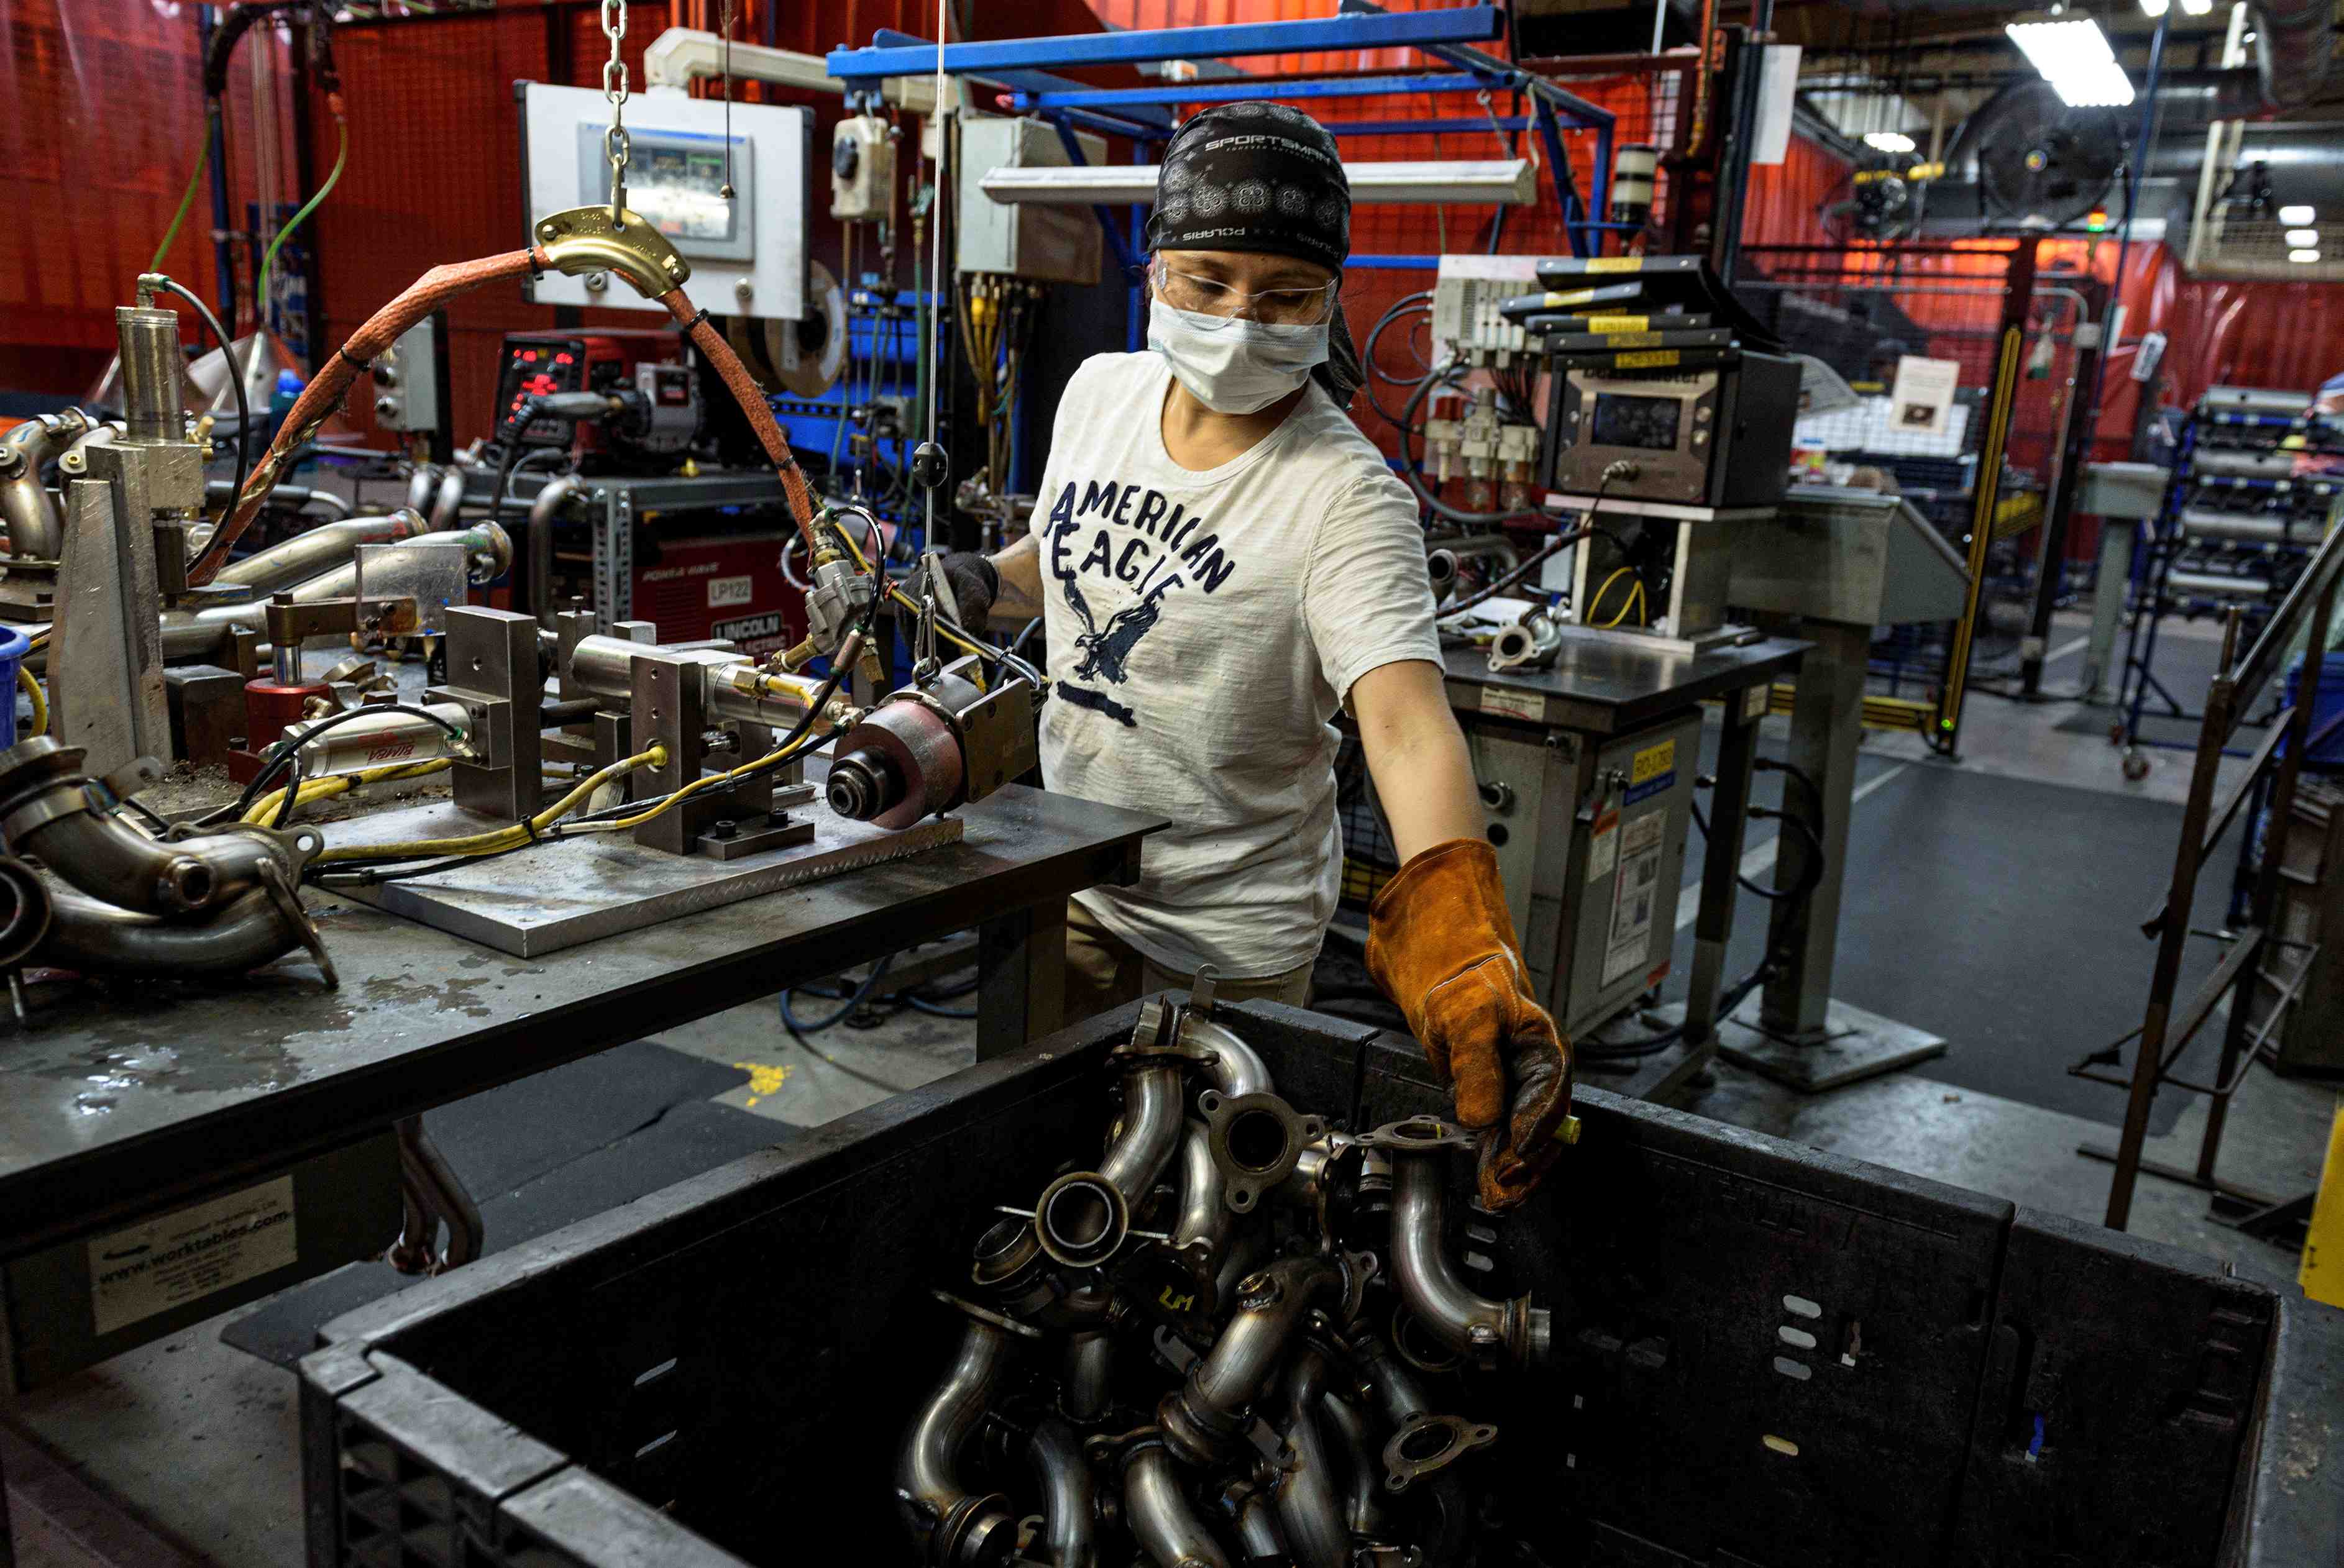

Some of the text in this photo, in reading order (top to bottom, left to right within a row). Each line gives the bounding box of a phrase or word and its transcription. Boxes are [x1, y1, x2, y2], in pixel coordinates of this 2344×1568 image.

[1205, 135, 1331, 166] SPORTSMAN
[1183, 227, 1245, 241] POLARIS
[1043, 480, 1235, 594] AMERICAN
[642, 562, 720, 581] POWER WAVE
[1051, 522, 1184, 604] EAGLE
[712, 581, 749, 601] LP122
[716, 615, 780, 640] LINCOLN
[369, 745, 415, 761] BIMBA
[99, 1210, 290, 1283] www.worktables.com
